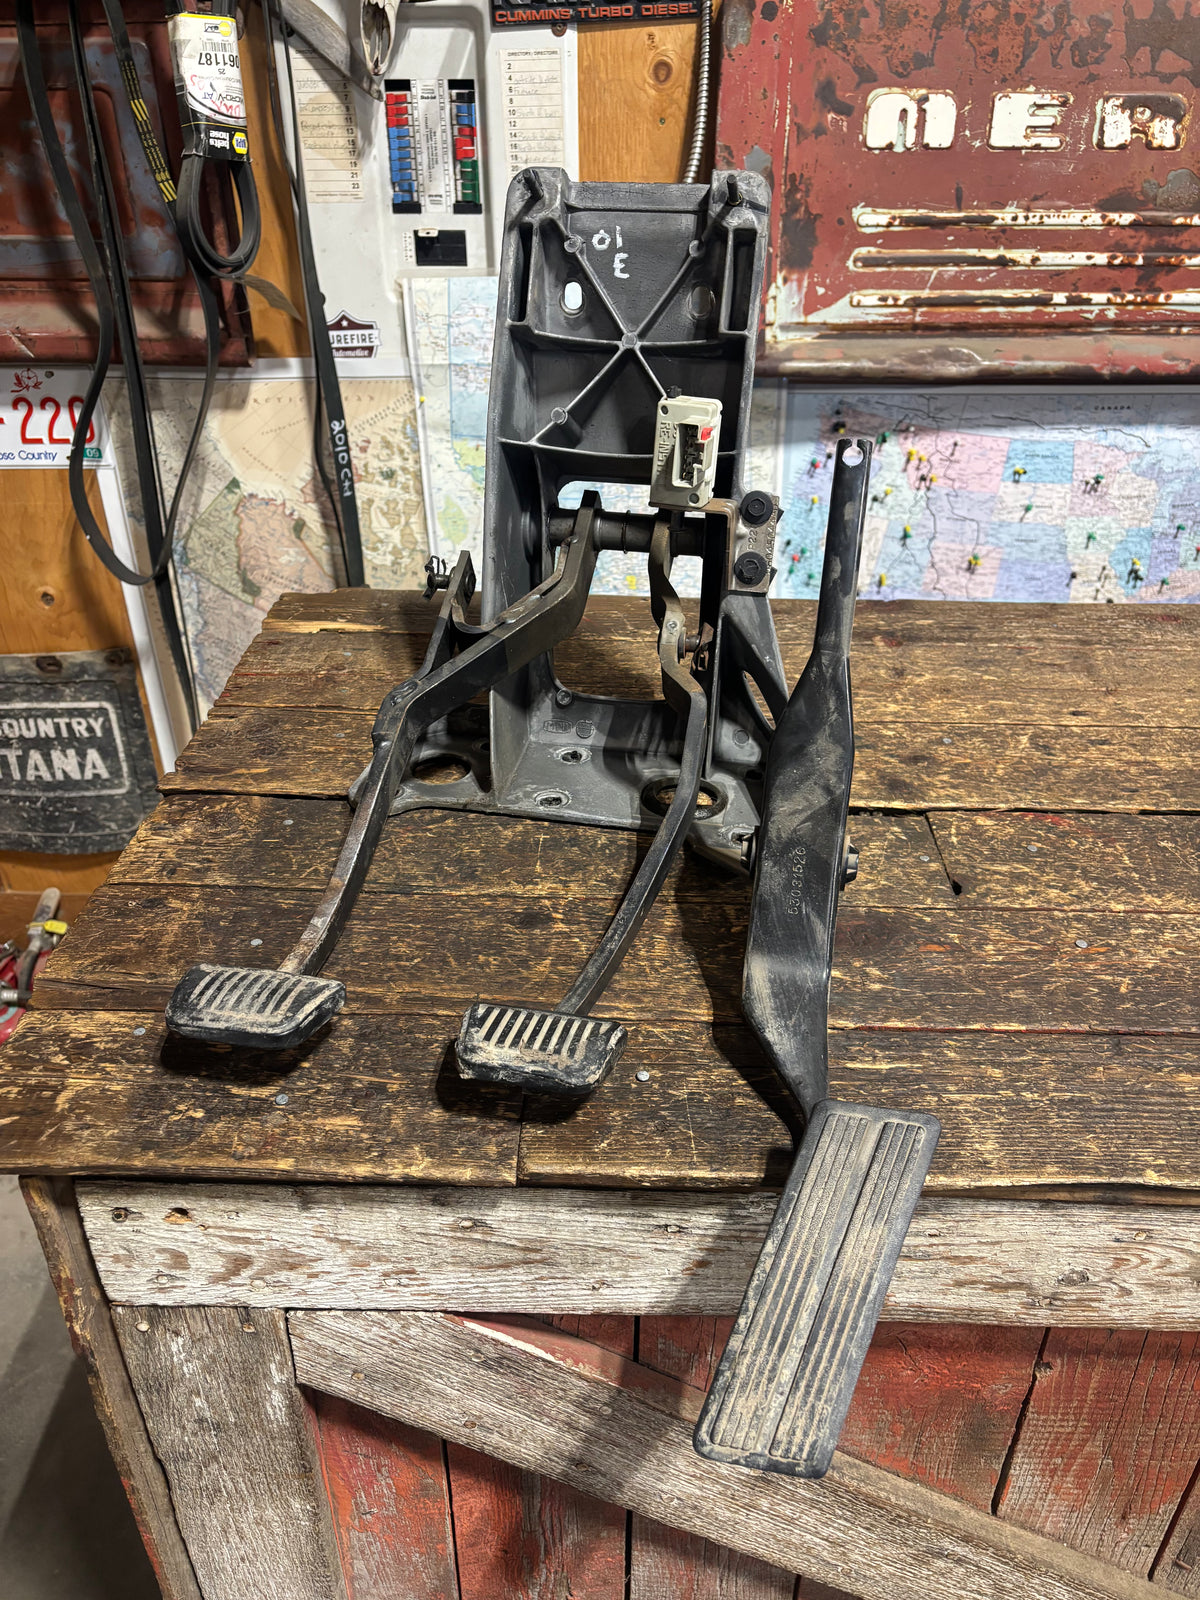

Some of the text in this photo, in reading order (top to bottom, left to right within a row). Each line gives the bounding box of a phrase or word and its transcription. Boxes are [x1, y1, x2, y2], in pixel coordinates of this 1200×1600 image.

[495, 9, 571, 23] CUMMINS
[577, 5, 634, 19] TURBO
[641, 3, 698, 16] DIESEL
[863, 88, 1187, 152] MER
[209, 130, 230, 140] hose
[346, 127, 354, 135] 13
[209, 138, 230, 150] belts
[234, 138, 247, 149] NAPA
[352, 182, 360, 190] 23
[330, 333, 375, 345] UREFIRE
[330, 419, 348, 465] 2010
[18, 450, 58, 462] Country
[86, 448, 100, 458] 09
[0, 717, 104, 738] OUNTRY
[0, 748, 111, 781] TANA
